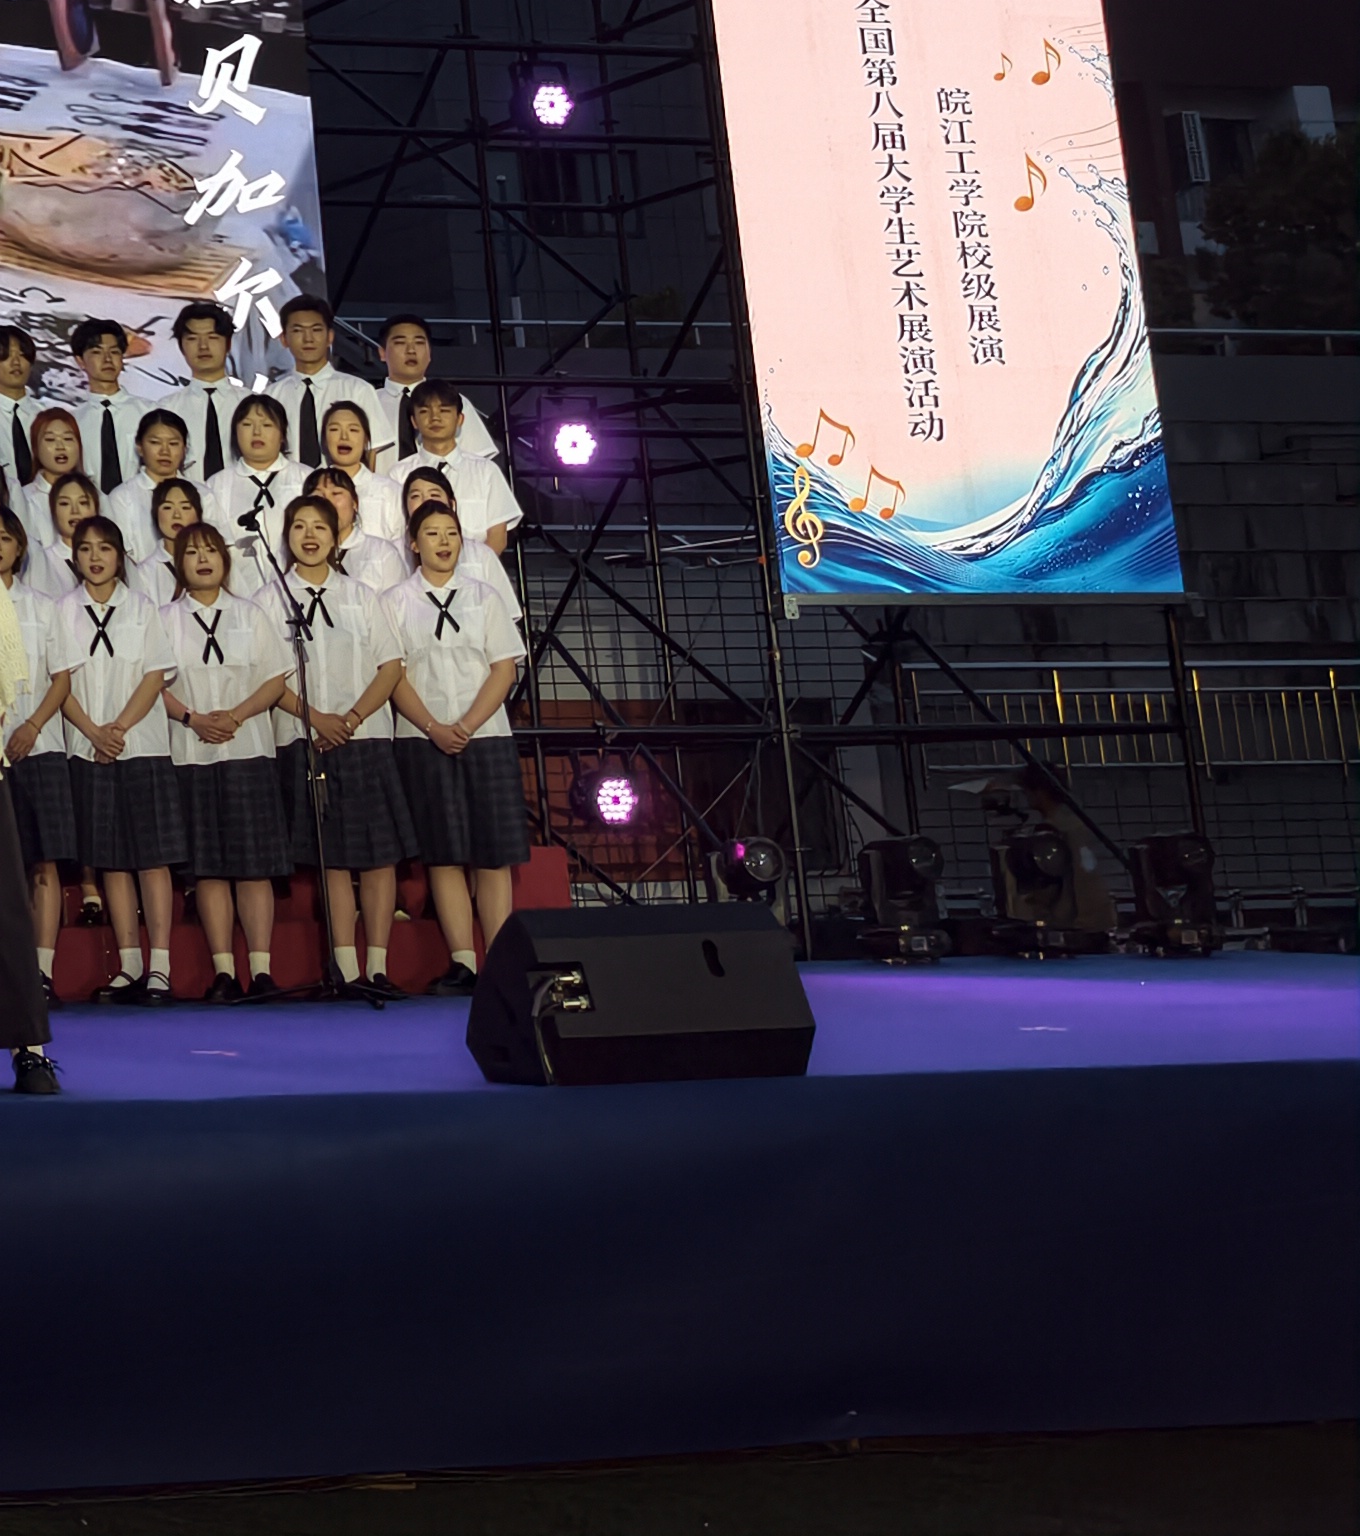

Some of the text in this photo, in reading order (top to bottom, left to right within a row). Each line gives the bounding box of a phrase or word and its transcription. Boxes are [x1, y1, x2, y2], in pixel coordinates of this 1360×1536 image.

[935, 86, 1007, 366] 皖江工学院校级展演
